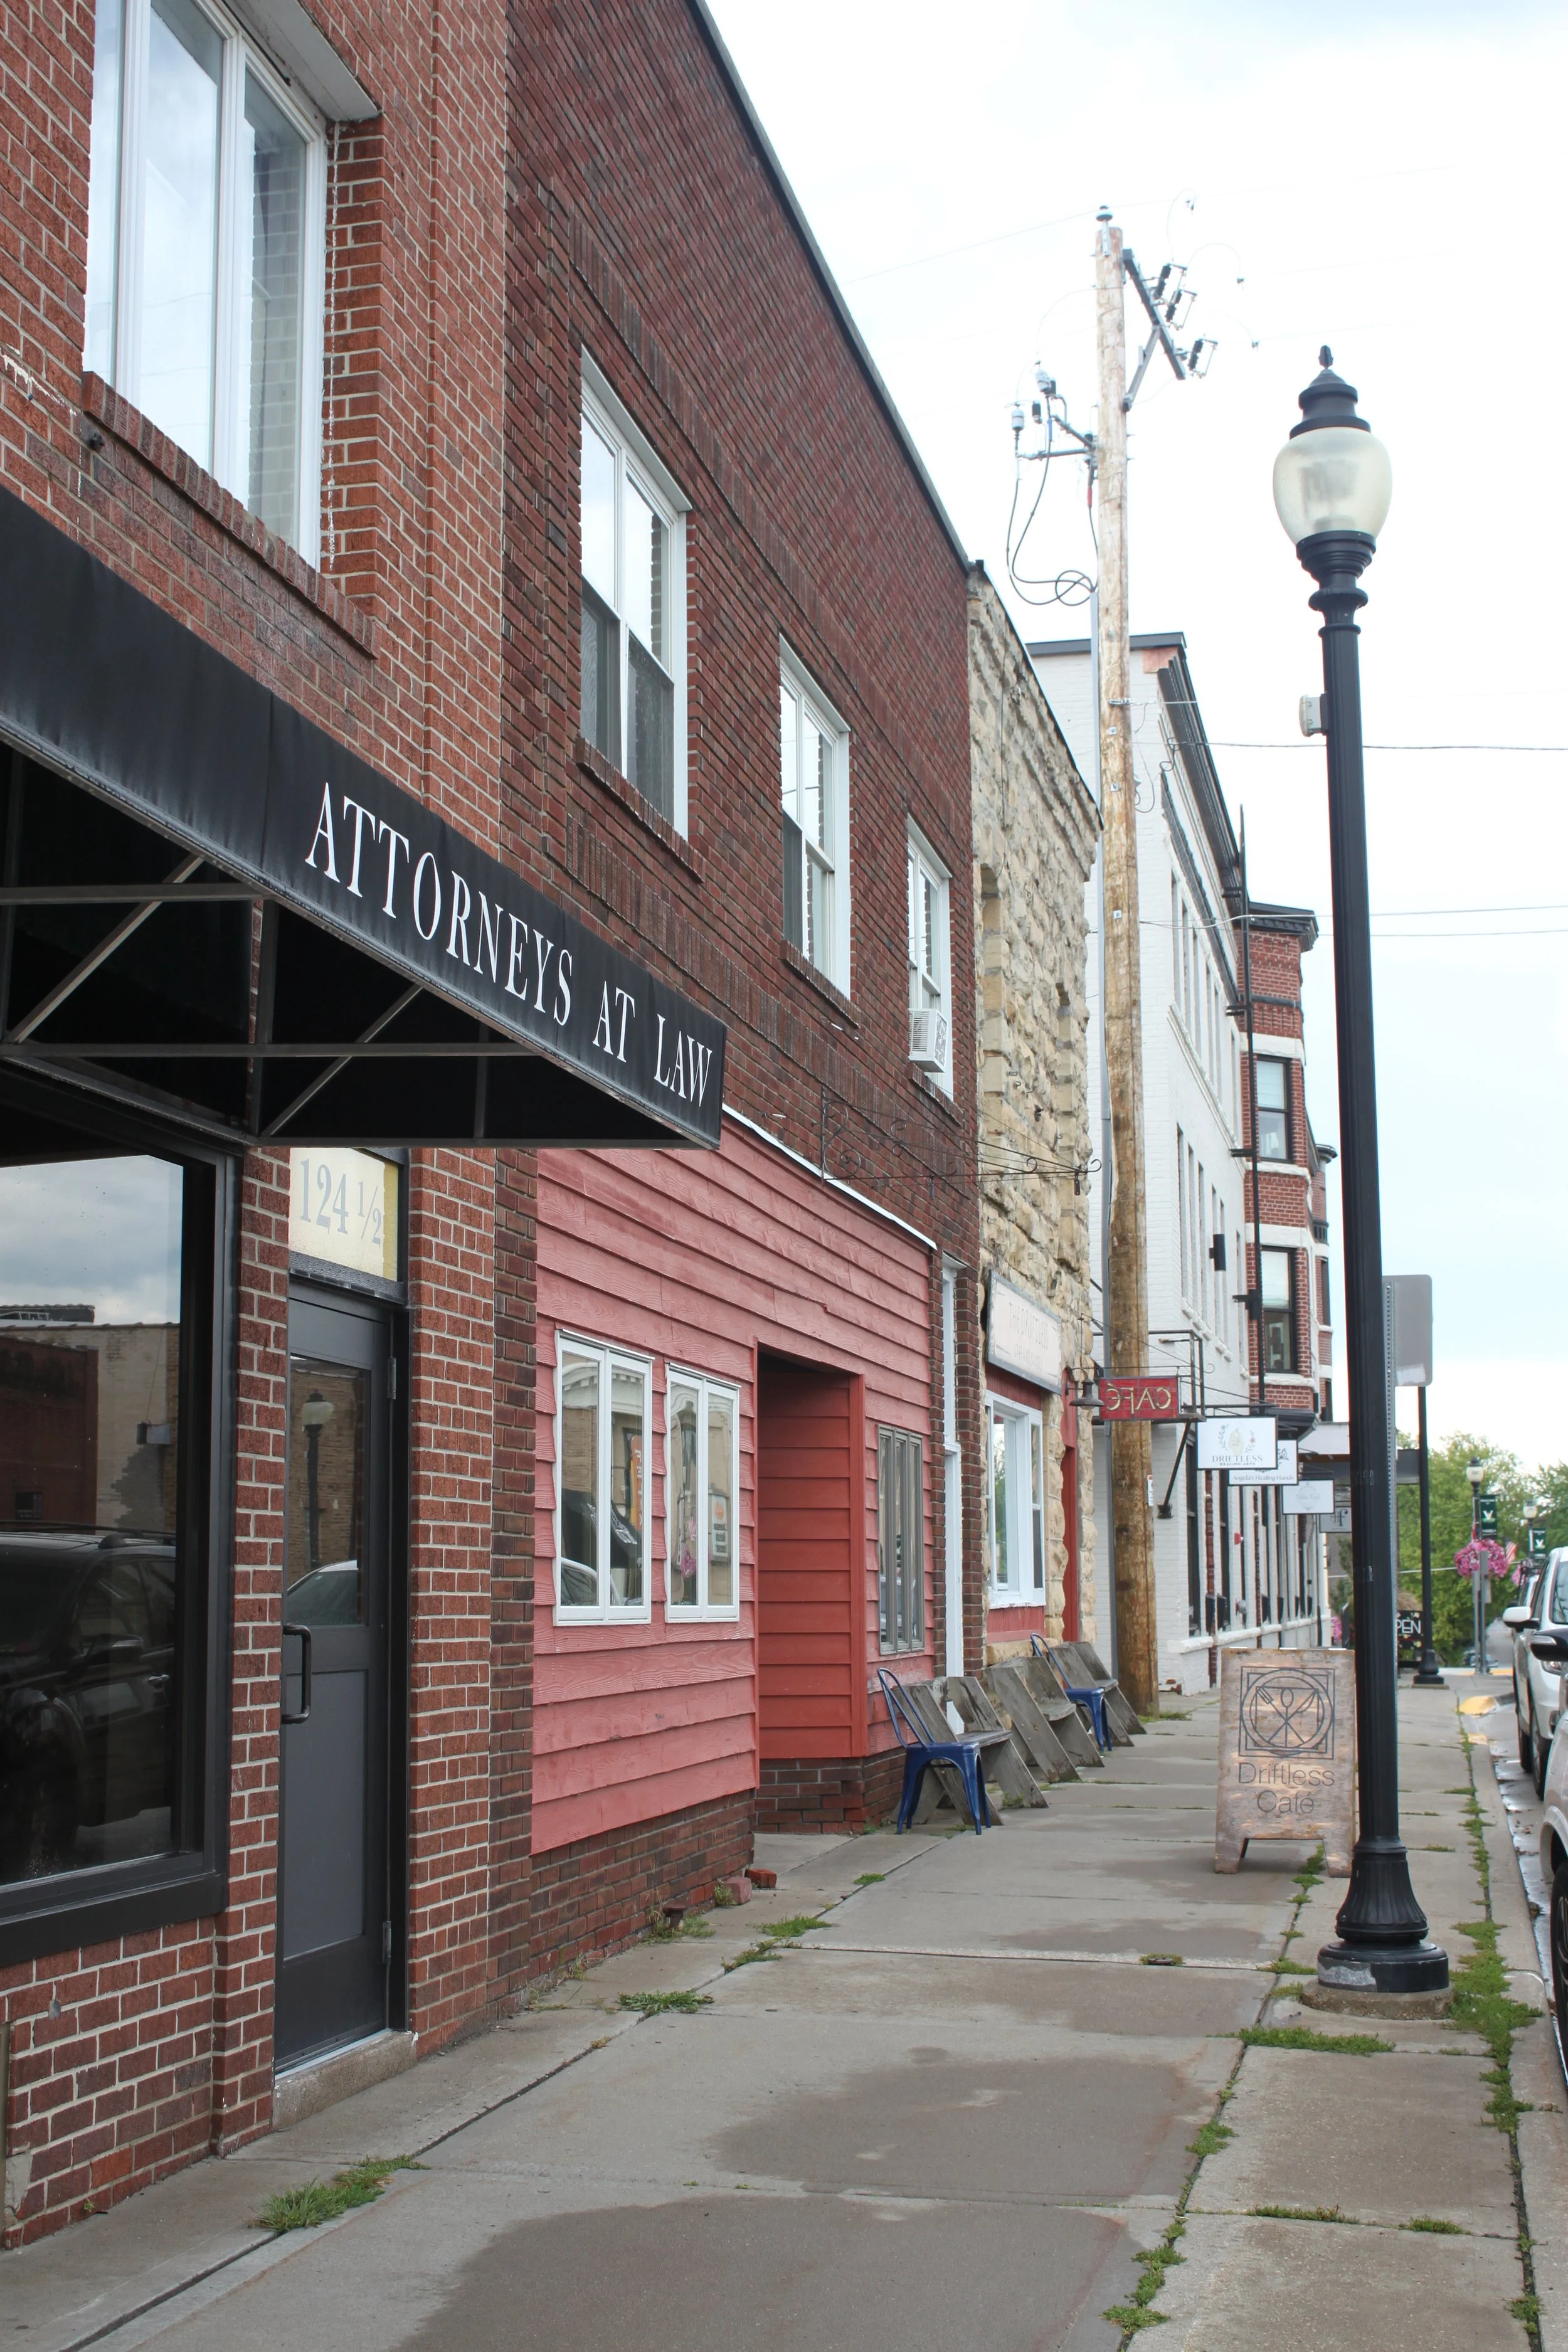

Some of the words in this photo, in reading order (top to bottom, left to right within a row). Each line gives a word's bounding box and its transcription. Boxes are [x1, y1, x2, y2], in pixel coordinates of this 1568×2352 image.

[304, 781, 574, 1027] ATTORNEYS
[593, 980, 636, 1063] AT
[653, 1013, 713, 1108] LAW
[300, 1158, 349, 1235] 124
[1009, 1301, 1020, 1333] THE
[1396, 1619, 1421, 1634] PEN
[1239, 1762, 1335, 1786] Driftless
[1257, 1790, 1315, 1814] Café
